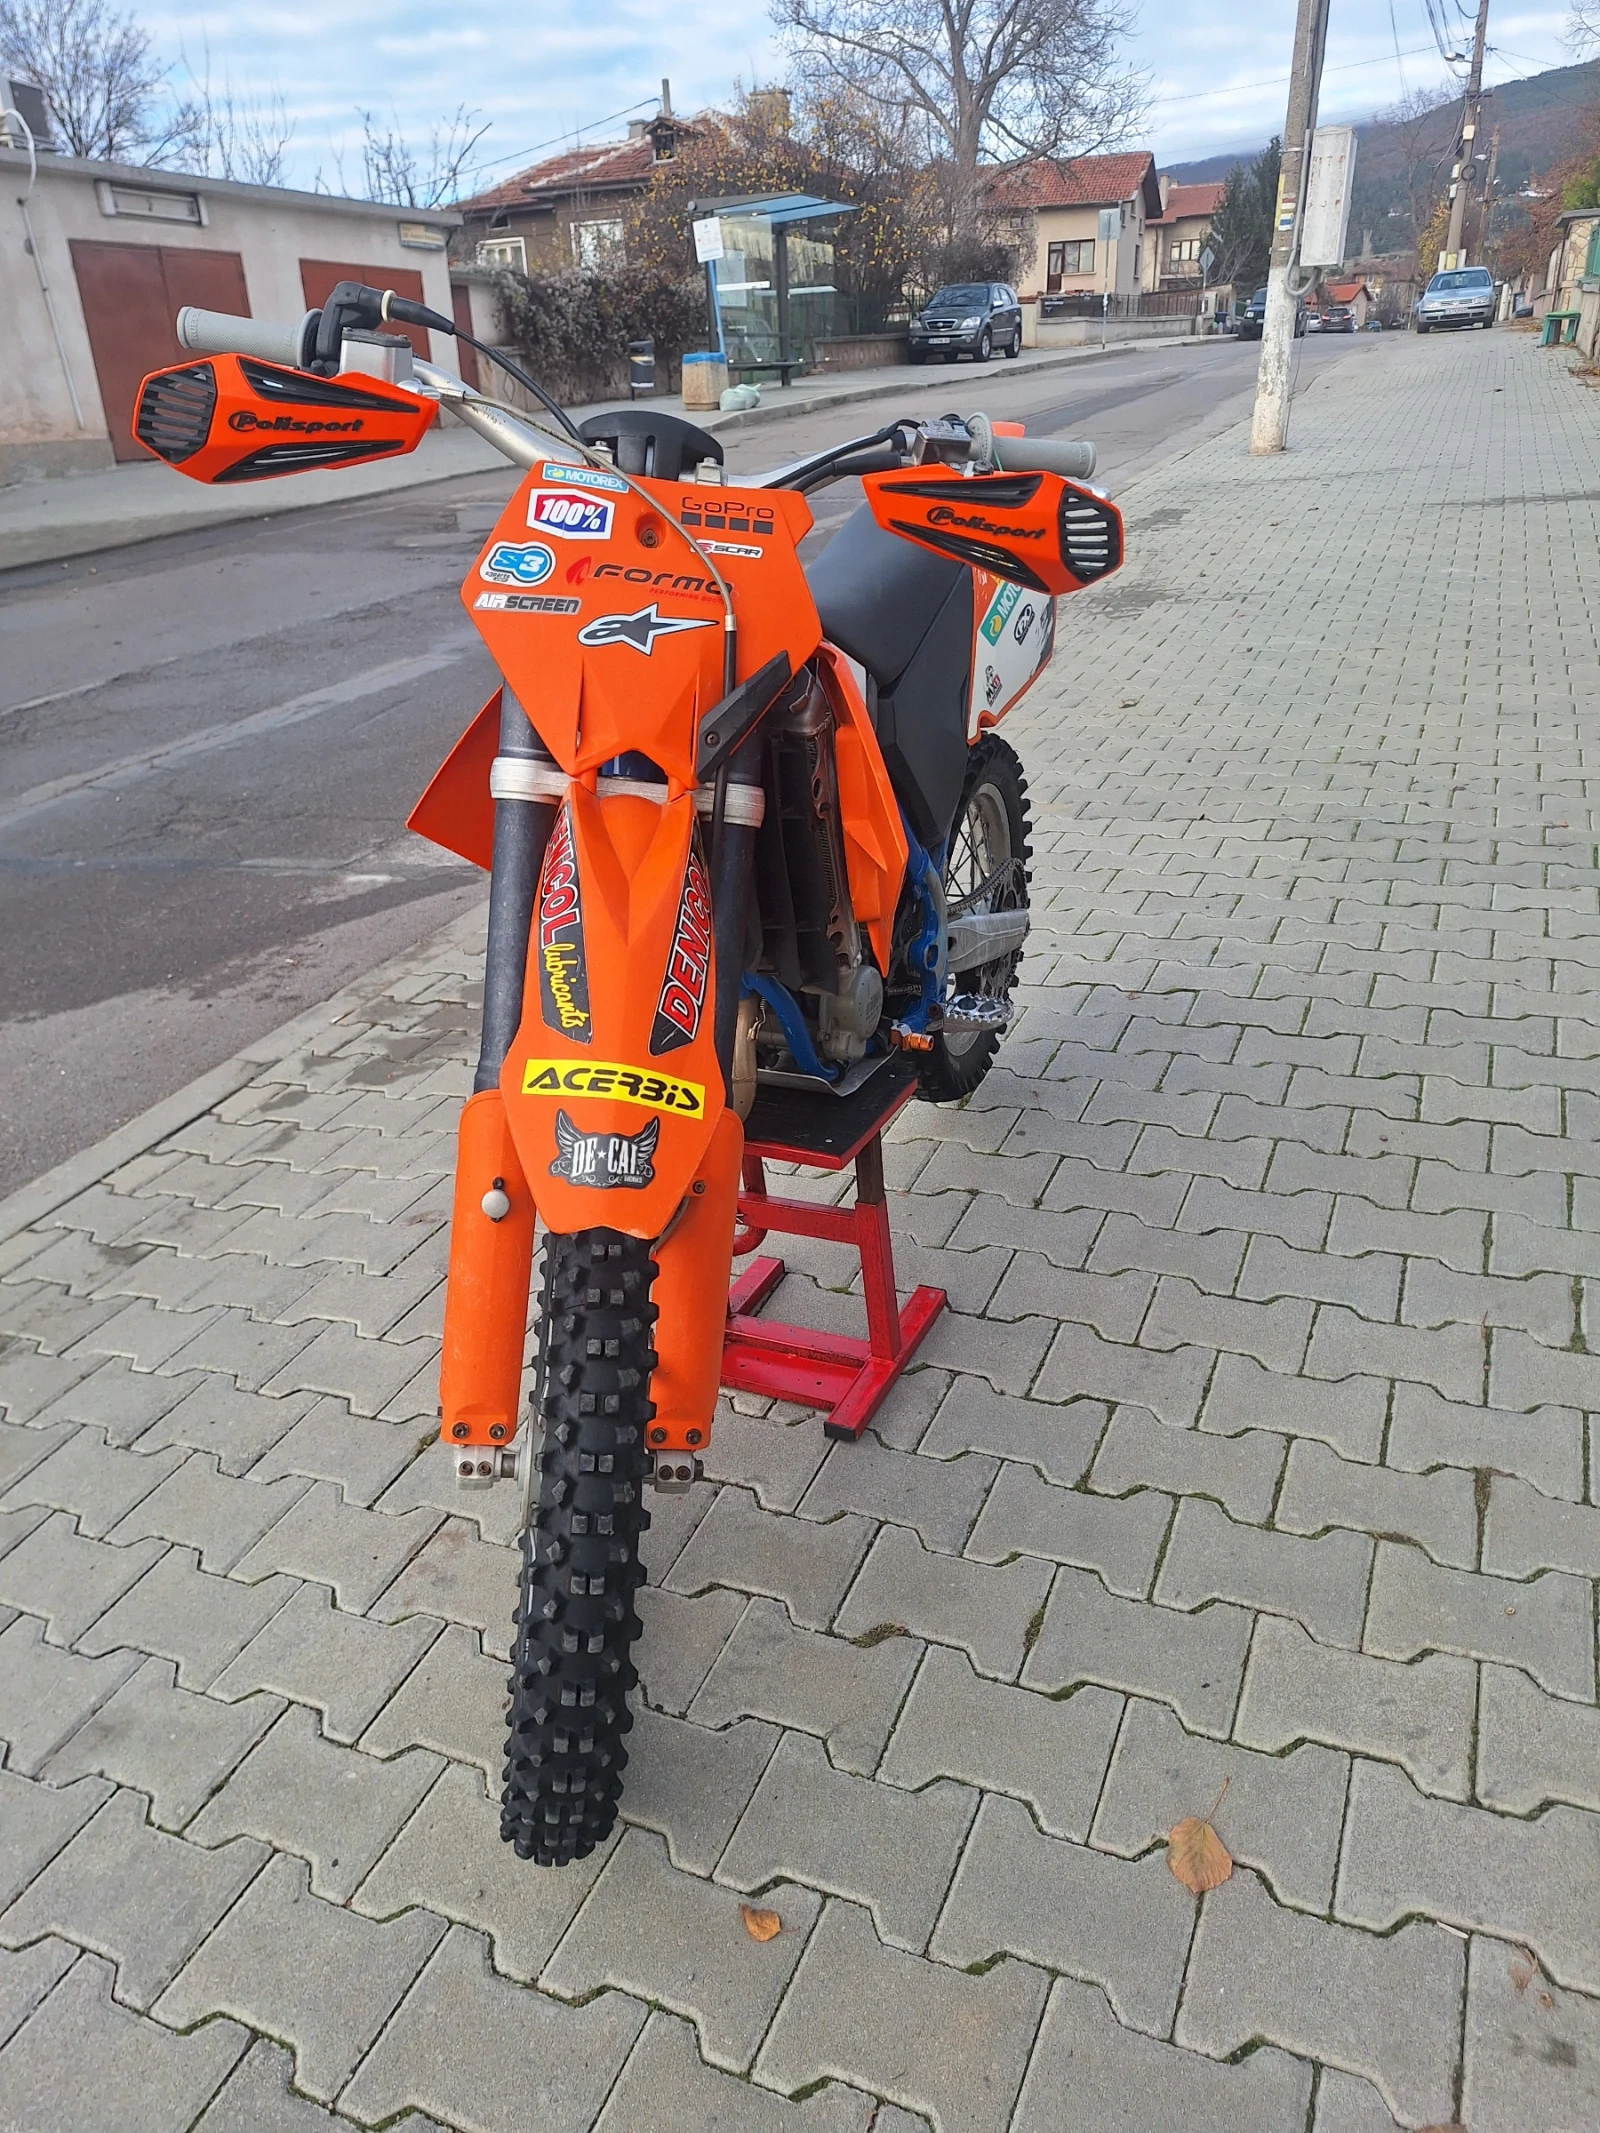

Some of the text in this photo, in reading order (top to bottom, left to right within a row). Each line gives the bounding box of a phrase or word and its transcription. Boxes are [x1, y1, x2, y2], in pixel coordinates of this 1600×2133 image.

[228, 410, 365, 433] Polisport
[565, 470, 624, 489] MOTOREX
[540, 498, 602, 530] 100%
[682, 496, 774, 519] GoPro
[926, 506, 1046, 539] Polisport
[713, 545, 761, 557] SCAR
[649, 587, 700, 601] PERFORMING
[543, 943, 590, 1029] lubricants
[571, 1137, 598, 1178] DE
